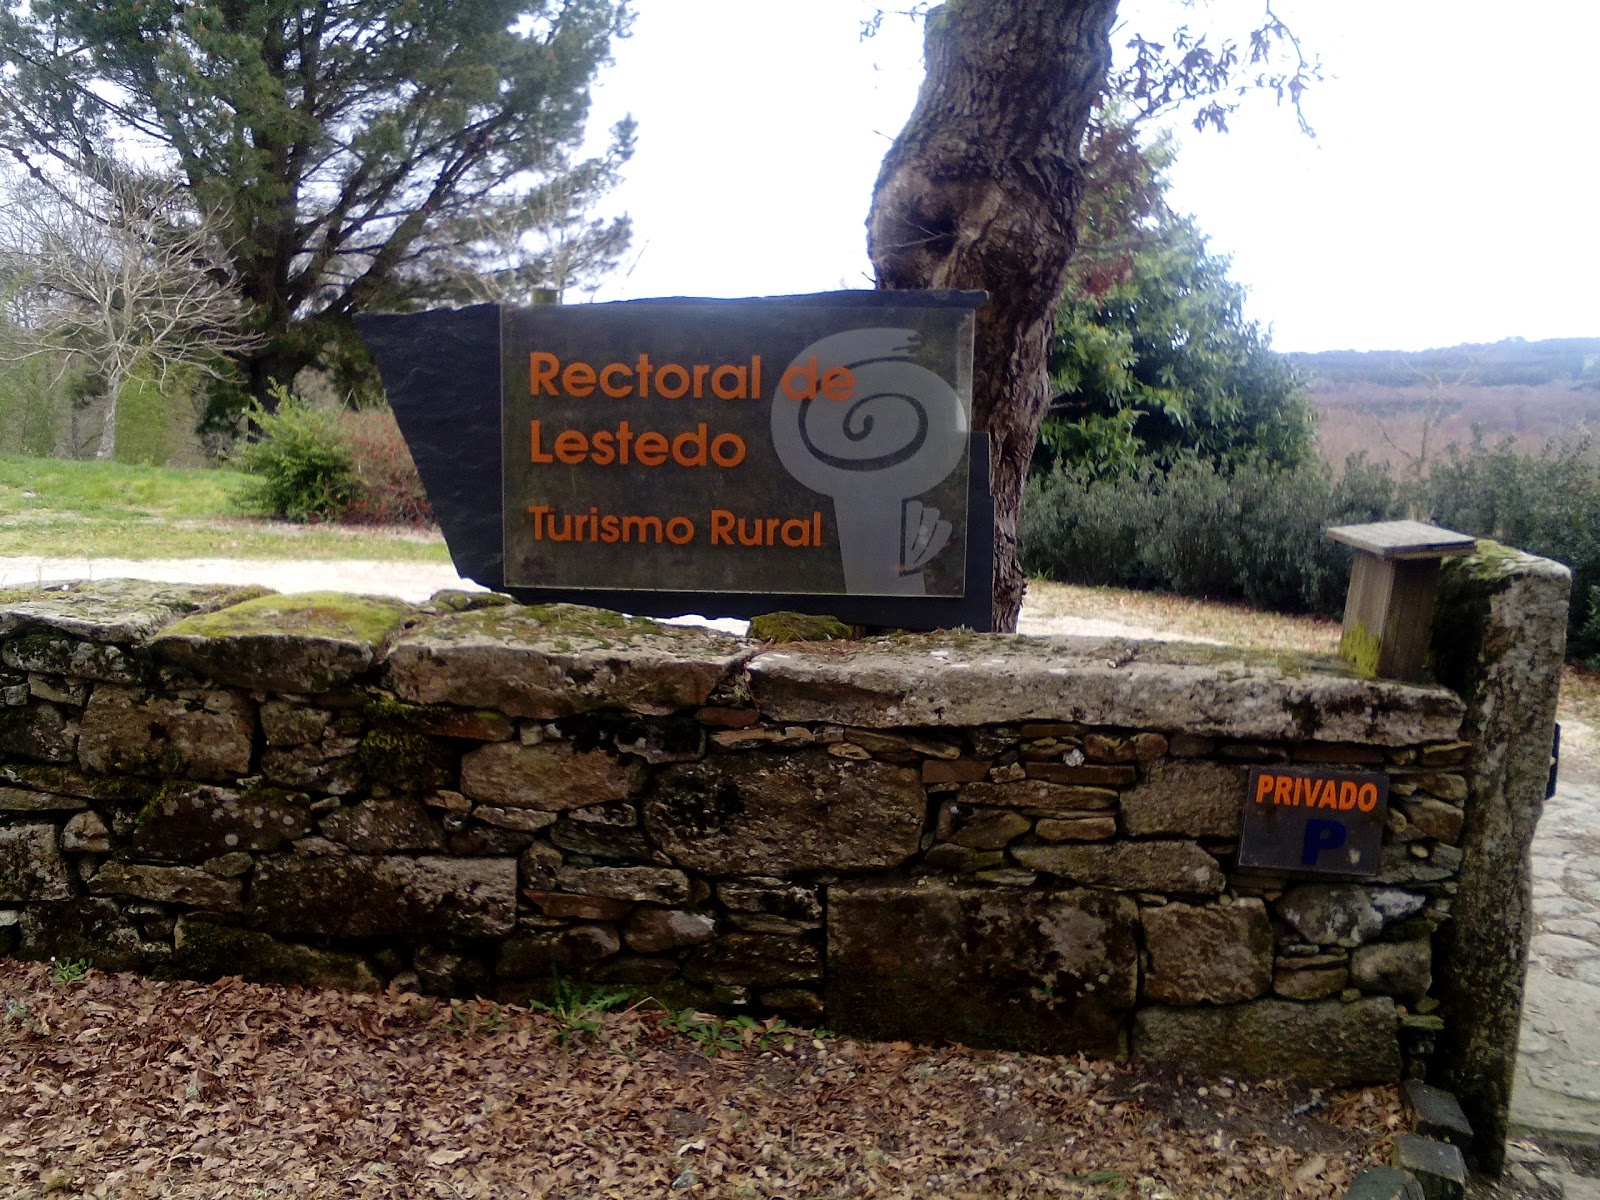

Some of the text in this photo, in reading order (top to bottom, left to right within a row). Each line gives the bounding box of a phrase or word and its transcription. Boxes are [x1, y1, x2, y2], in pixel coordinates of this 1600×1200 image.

[529, 351, 857, 400] Rectoral de
[529, 419, 747, 468] Lestedo
[528, 505, 823, 547] Turismo Rural
[1255, 774, 1378, 812] PRIVADO
[1301, 818, 1347, 866] P
